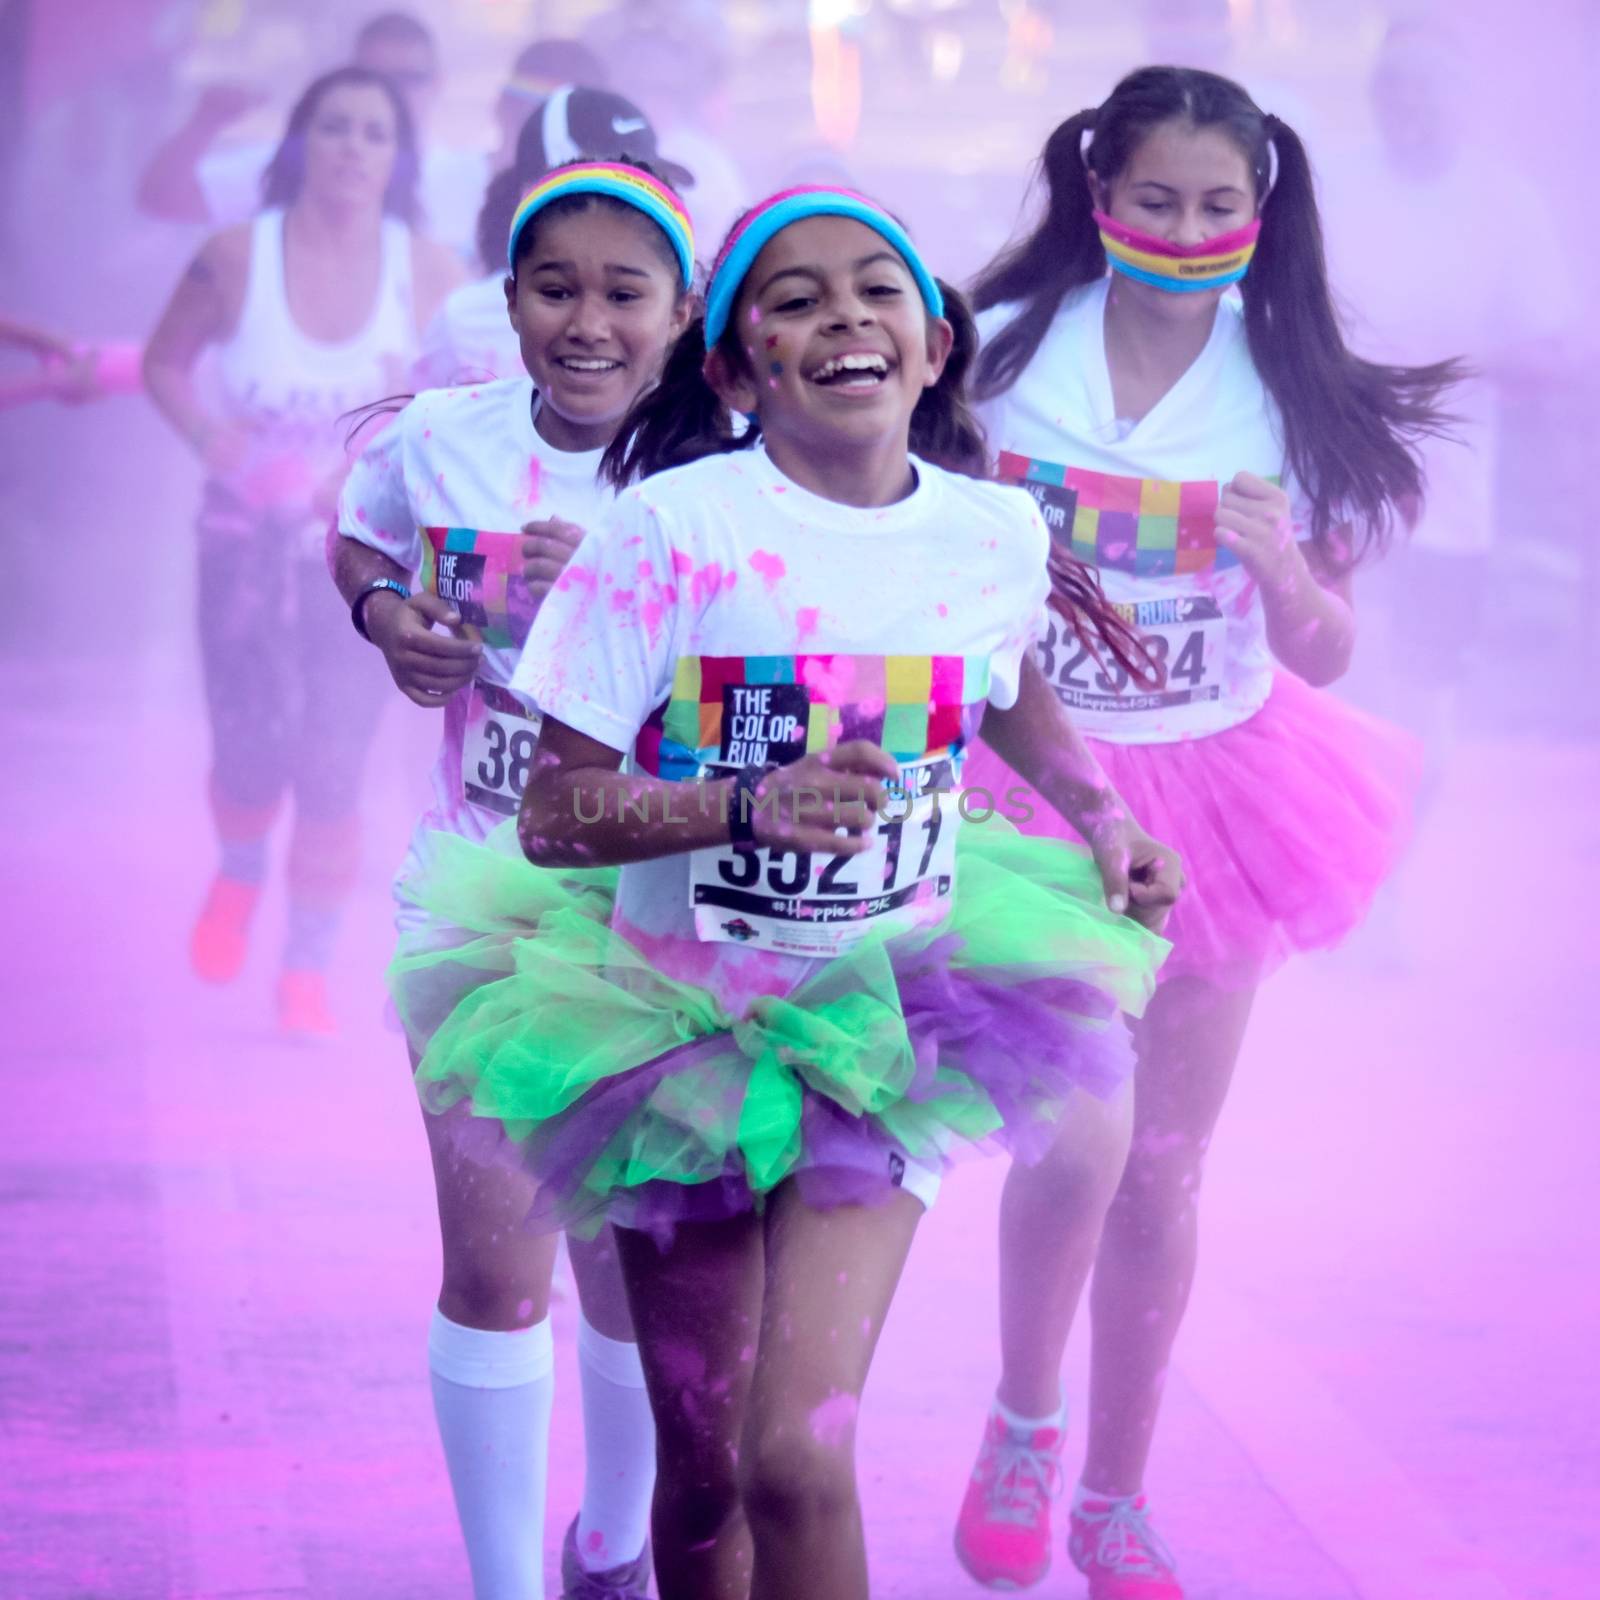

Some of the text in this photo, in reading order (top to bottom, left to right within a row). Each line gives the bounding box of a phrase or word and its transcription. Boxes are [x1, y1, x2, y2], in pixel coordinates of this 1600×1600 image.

[439, 554, 458, 577] THE
[438, 577, 474, 602] COLOR
[1138, 599, 1176, 624] RUN
[733, 688, 772, 715] THE
[731, 714, 797, 743] COLOR
[727, 740, 768, 768] RUN
